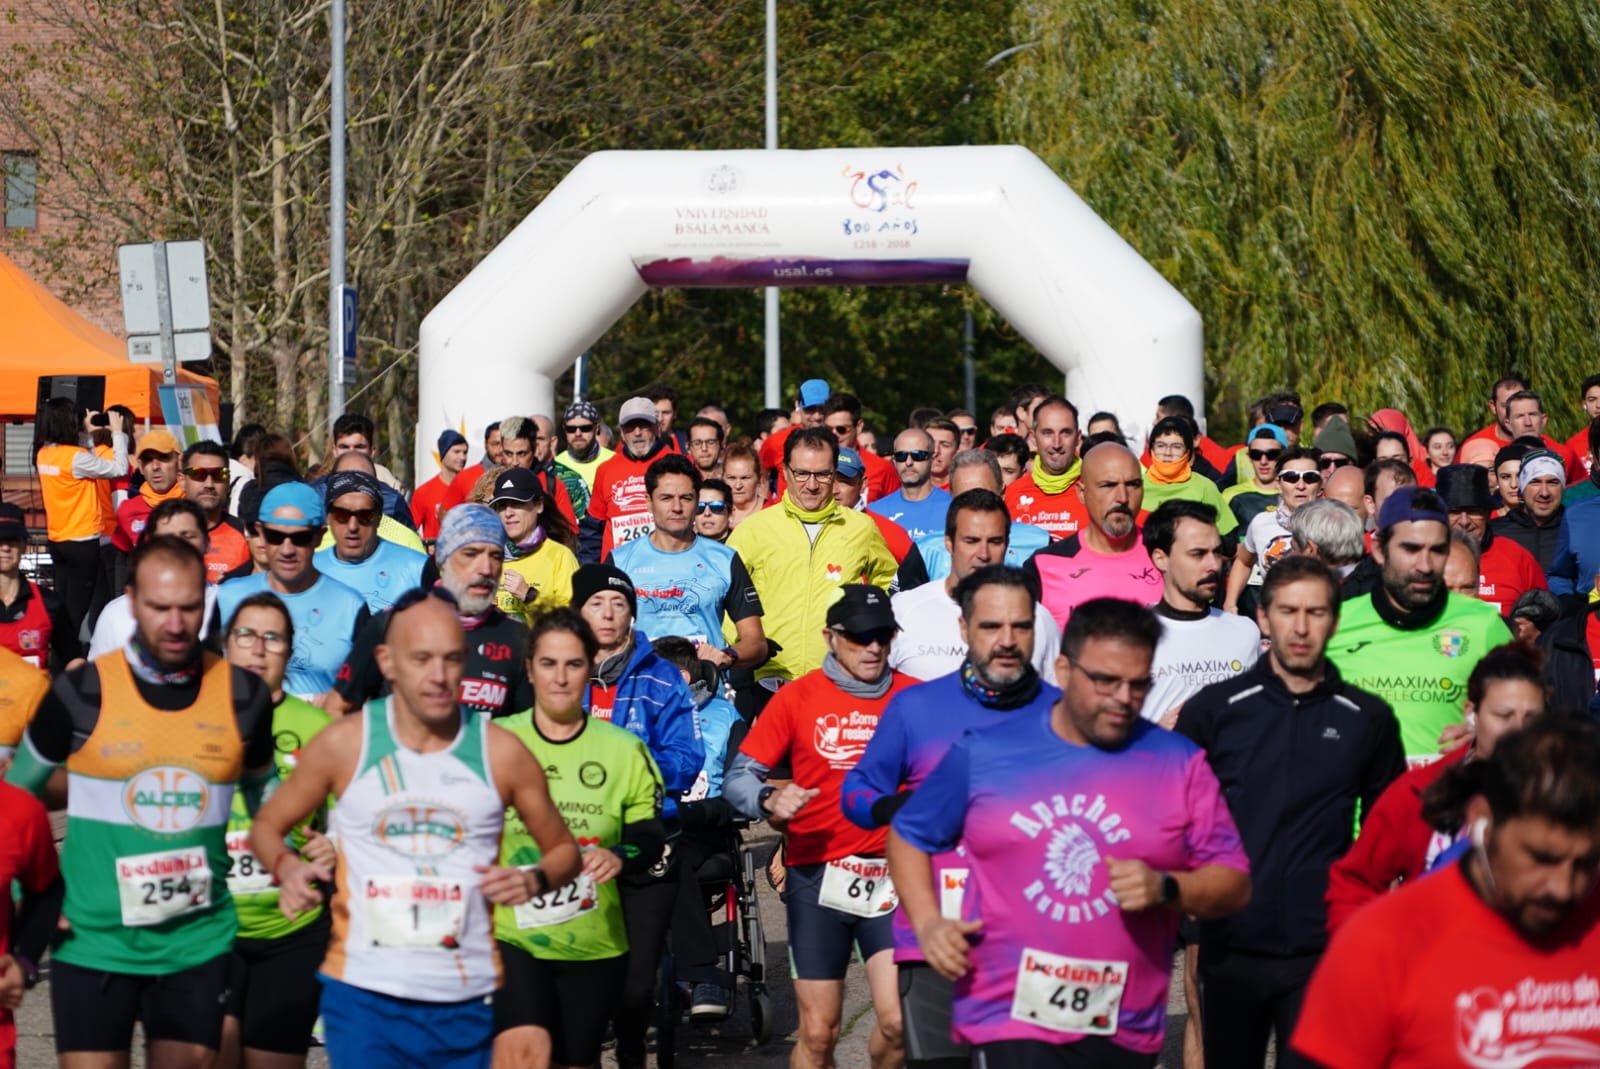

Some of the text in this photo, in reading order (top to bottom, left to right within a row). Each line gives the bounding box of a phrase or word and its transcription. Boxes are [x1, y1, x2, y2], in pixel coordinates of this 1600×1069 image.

[842, 219, 871, 236] 800
[773, 265, 834, 277] usal.es
[344, 294, 354, 352] P
[623, 525, 651, 542] 269
[918, 644, 966, 657] SANM
[460, 680, 507, 706] TEAM
[592, 704, 614, 719] Corr
[133, 790, 203, 811] ALCER
[556, 801, 604, 815] MINOS
[1009, 793, 1132, 845] Apaches
[225, 854, 269, 880] 28
[141, 875, 192, 905] 254
[848, 877, 876, 902] 69
[410, 903, 419, 931] 1
[1025, 955, 1123, 985] bedunia
[1049, 985, 1090, 1013] 48
